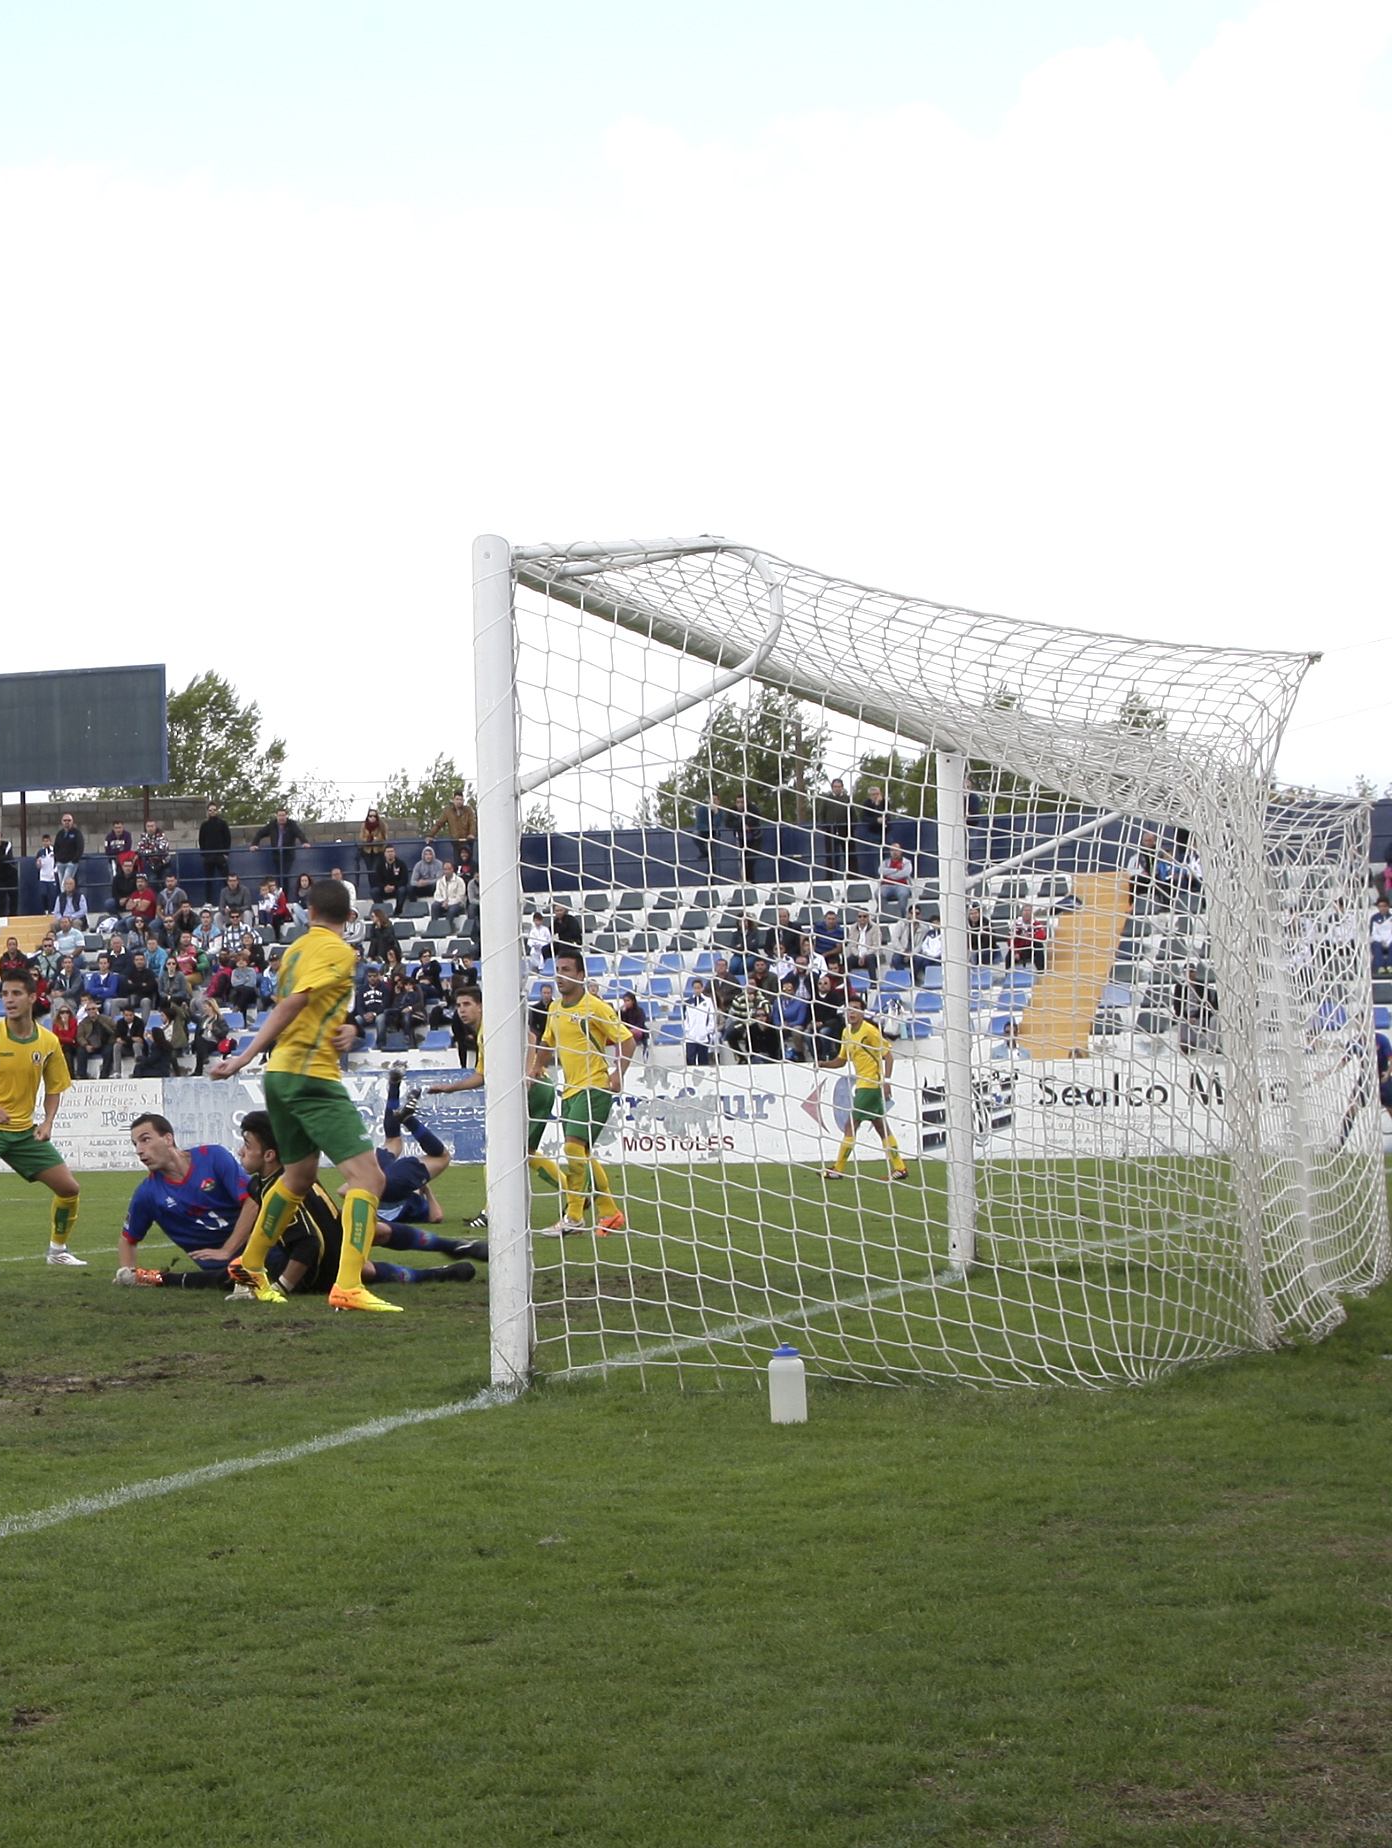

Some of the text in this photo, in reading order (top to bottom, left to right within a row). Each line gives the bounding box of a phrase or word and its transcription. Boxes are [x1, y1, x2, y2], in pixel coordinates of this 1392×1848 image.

[60, 1096, 81, 1107] Luis
[55, 1112, 88, 1120] XCLUSIVO
[622, 1136, 735, 1152] MOSTOLES
